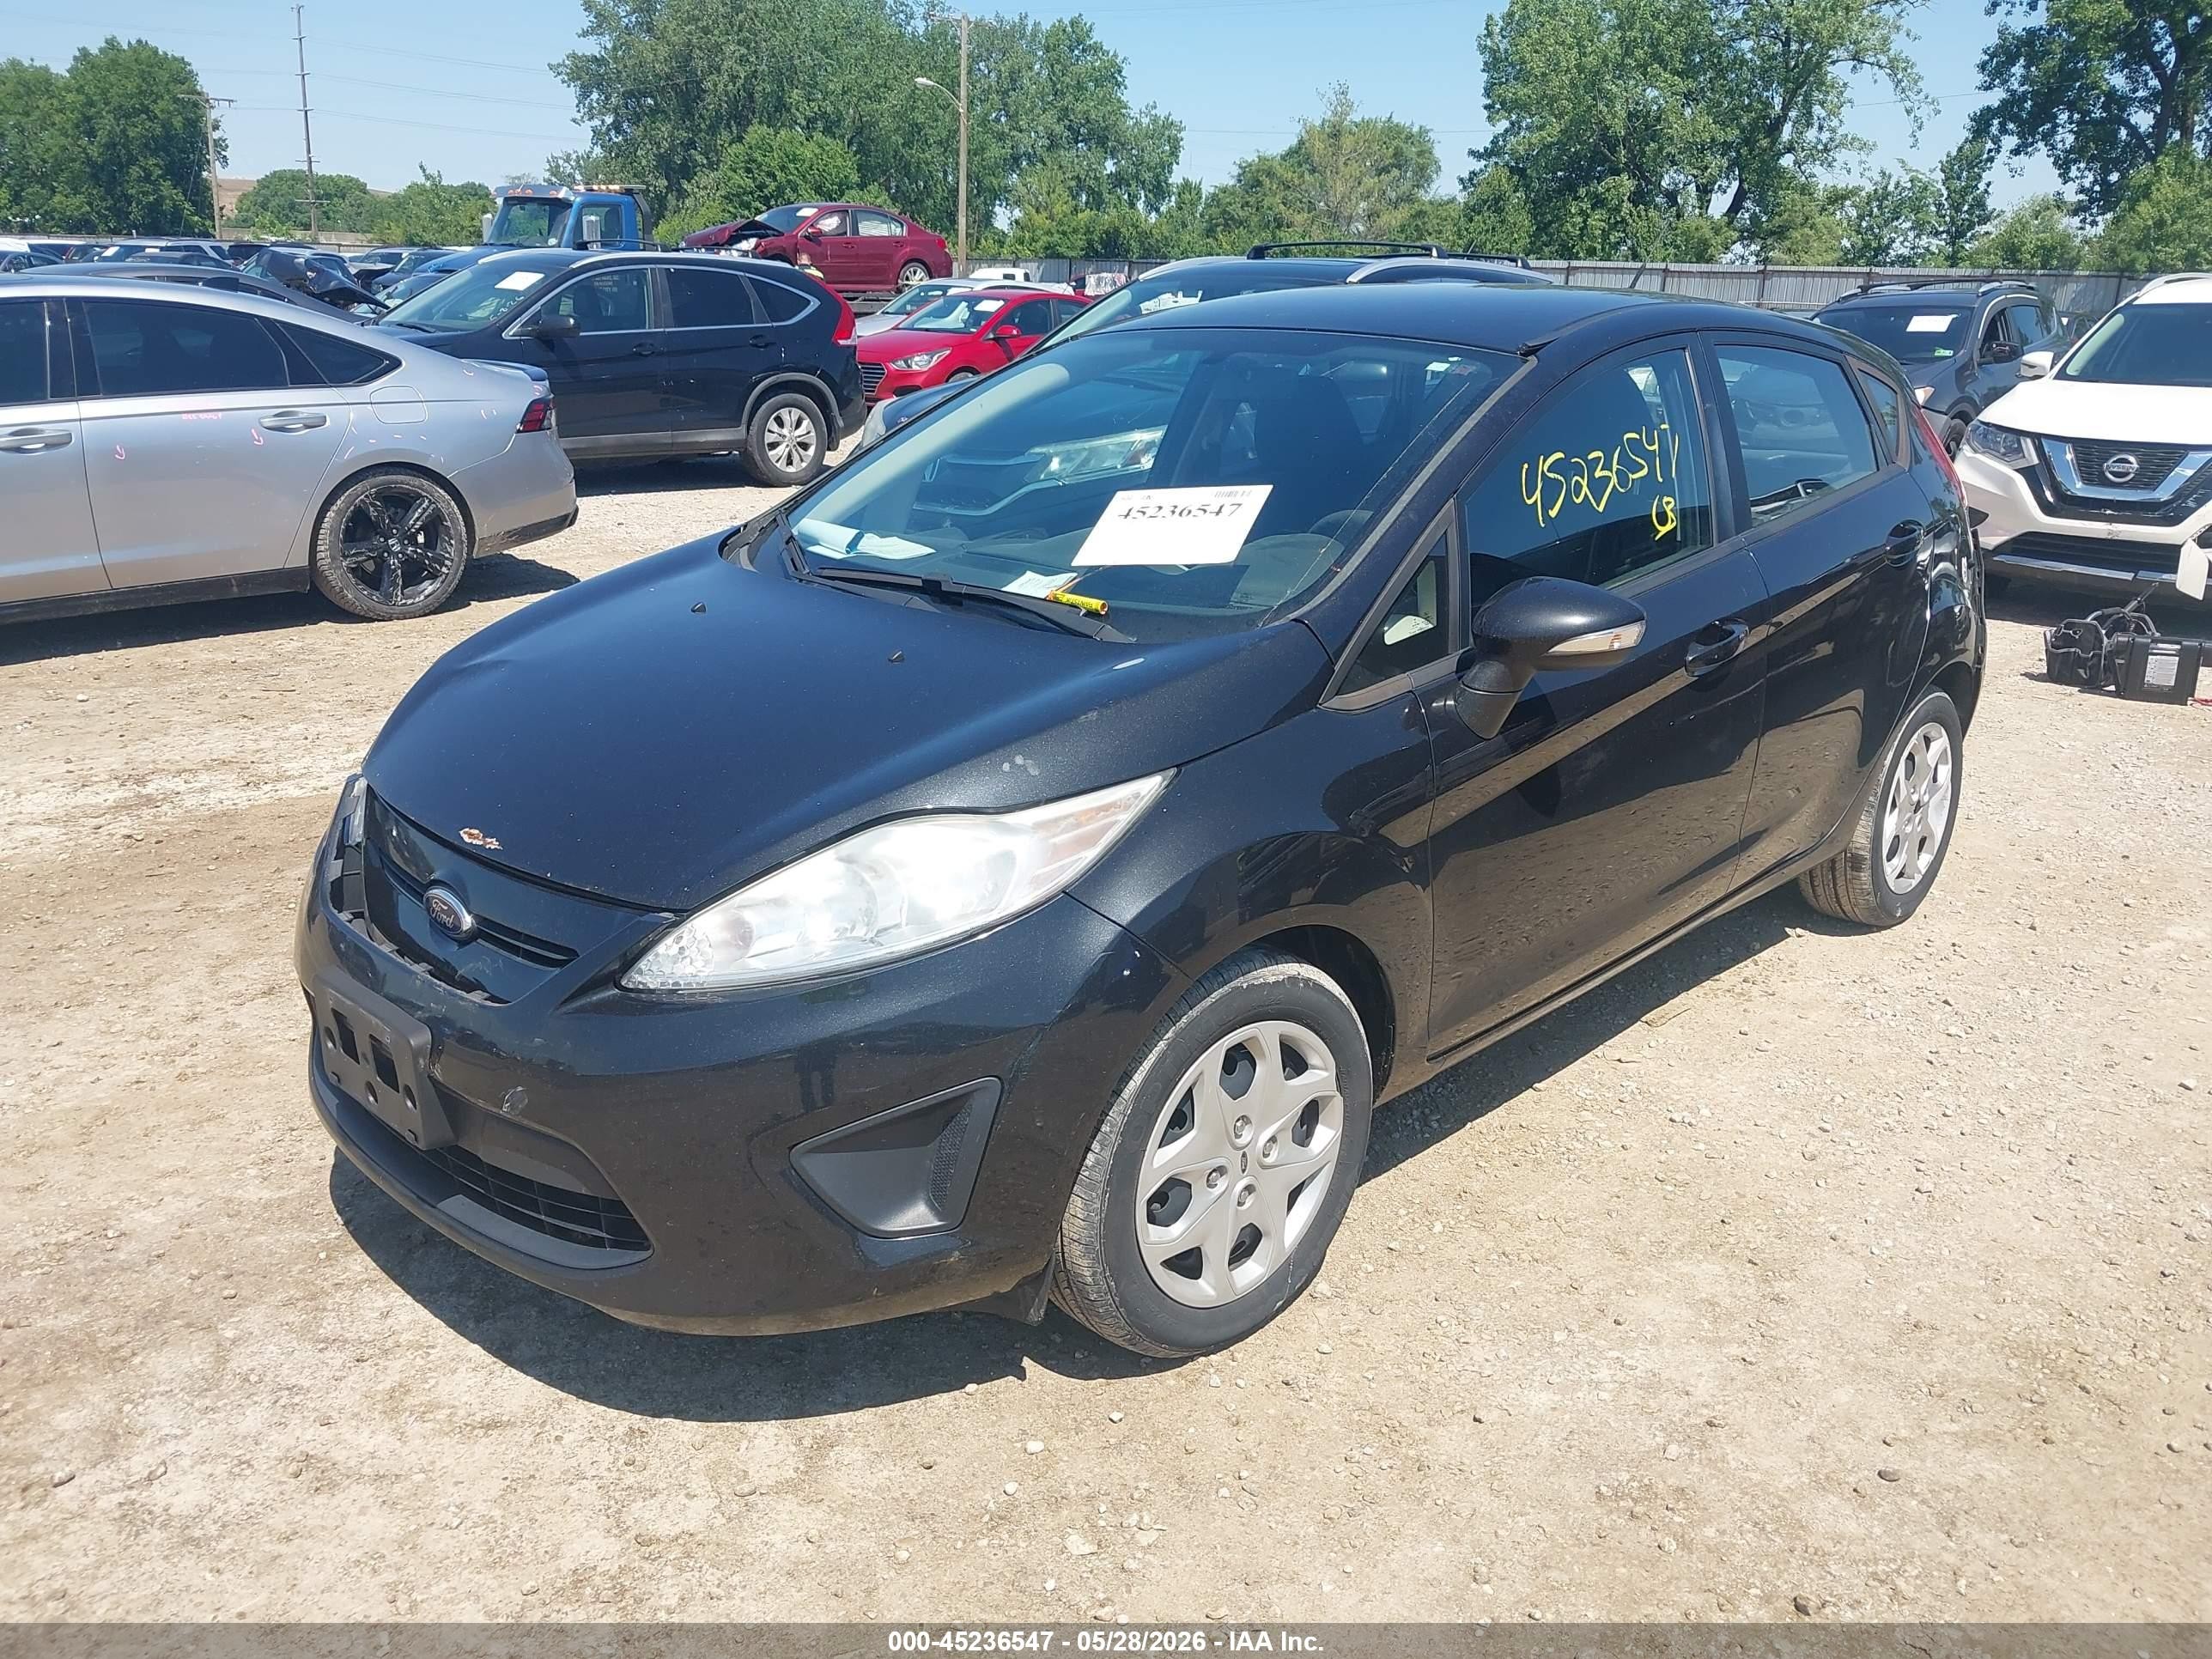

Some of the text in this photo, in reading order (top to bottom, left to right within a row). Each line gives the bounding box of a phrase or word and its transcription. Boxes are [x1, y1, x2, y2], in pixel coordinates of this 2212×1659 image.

[1522, 423, 1679, 528] 45236547
[1118, 502, 1243, 520] 45236547
[430, 899, 454, 927] Ford
